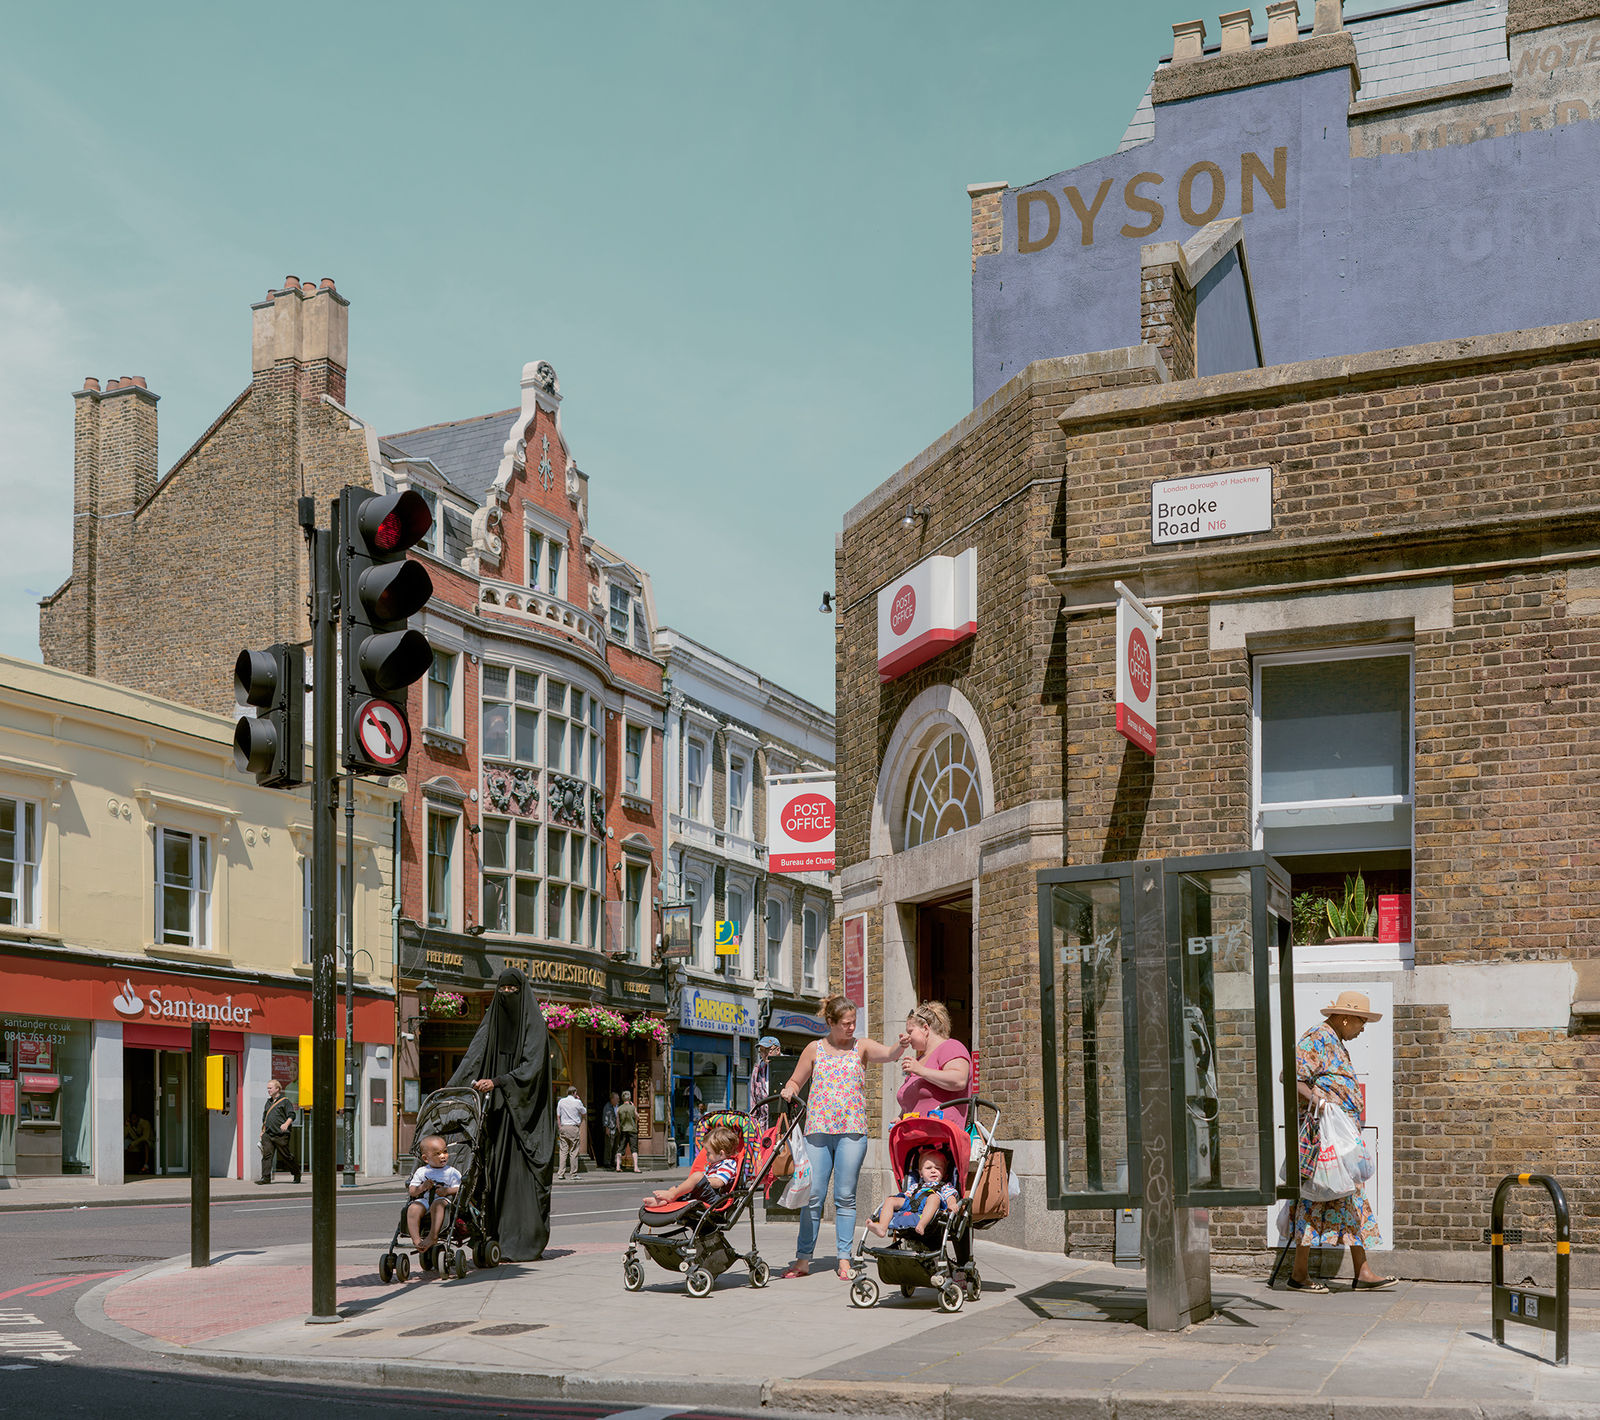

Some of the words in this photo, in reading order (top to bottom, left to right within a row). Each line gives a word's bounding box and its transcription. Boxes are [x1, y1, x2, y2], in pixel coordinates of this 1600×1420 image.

[1017, 146, 1288, 254] DYSON
[1163, 485, 1188, 494] London
[1190, 481, 1219, 490] Borough
[1221, 478, 1228, 487] of
[1230, 475, 1260, 485] Hackney
[1158, 498, 1217, 519] Brooke
[1158, 517, 1200, 537] Road
[1208, 519, 1227, 531] N16
[896, 591, 912, 611] POST
[892, 604, 913, 627] OFFICE
[1133, 639, 1147, 667] POST
[1130, 658, 1149, 688] OFFICE
[794, 803, 826, 816] POST
[786, 816, 831, 831] OFFICE
[781, 858, 804, 867] Bureau
[805, 857, 814, 865] de
[815, 857, 836, 866] Chang
[1060, 944, 1095, 964] BT
[1188, 935, 1225, 955] BT
[426, 949, 443, 963] FREE
[443, 951, 464, 967] HOUSE
[531, 959, 588, 984] ROCHESTER
[149, 989, 253, 1024] Santander
[695, 997, 745, 1025] PARKER'S
[684, 1018, 694, 1026] PET
[696, 1020, 715, 1030] FOODS
[717, 1023, 729, 1032] AND
[4, 1031, 27, 1041] 0845
[1512, 1295, 1519, 1312] P
